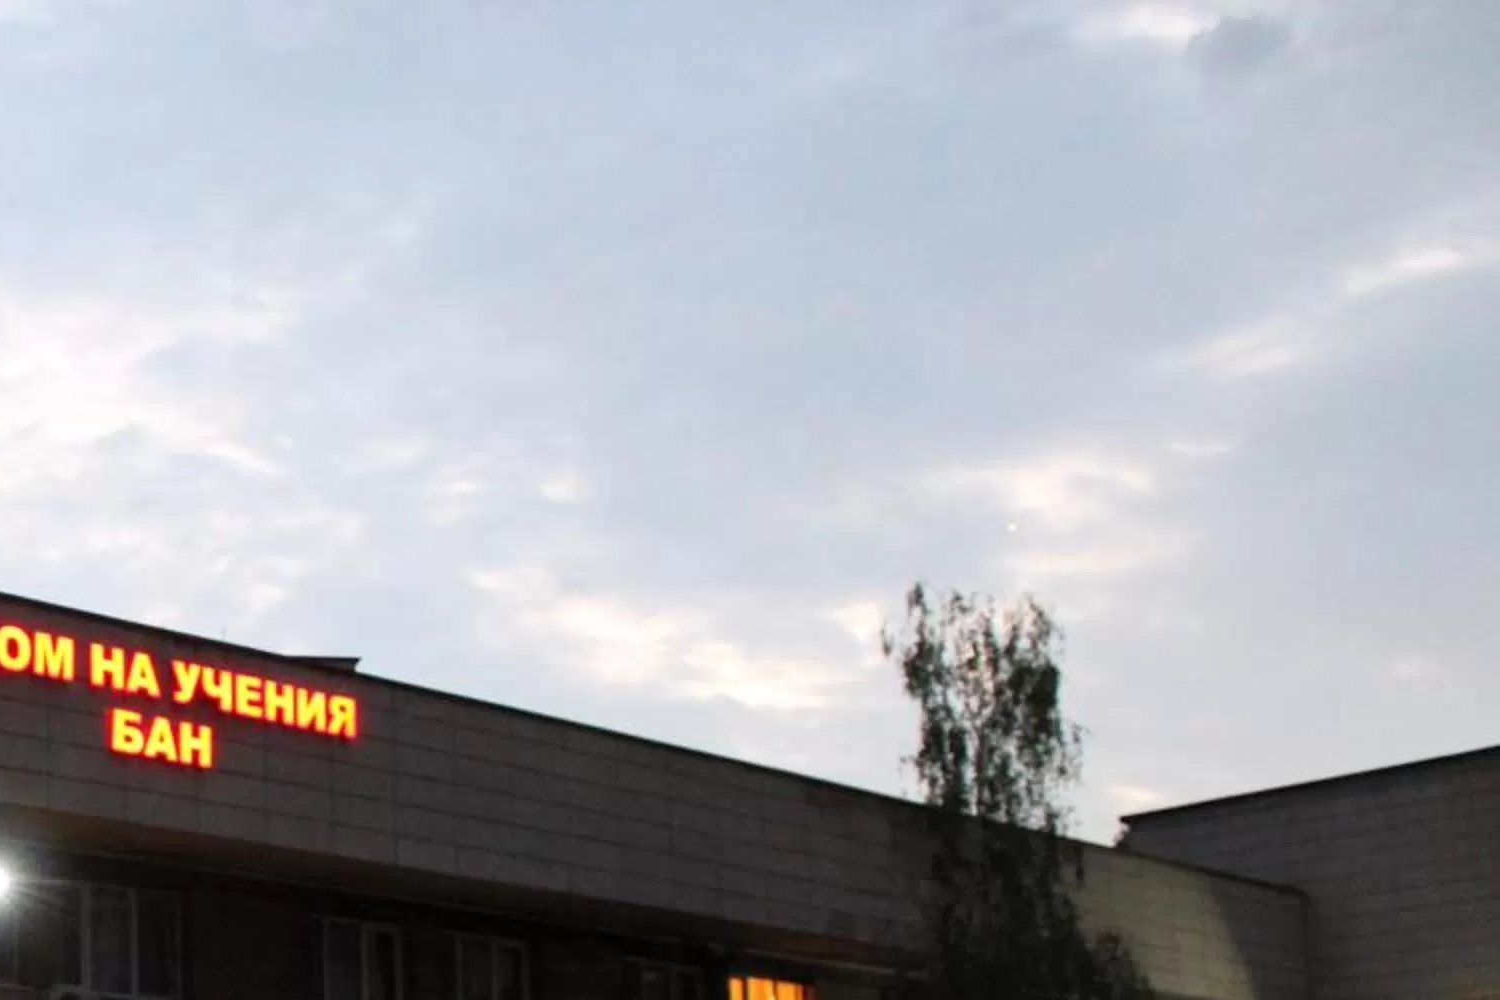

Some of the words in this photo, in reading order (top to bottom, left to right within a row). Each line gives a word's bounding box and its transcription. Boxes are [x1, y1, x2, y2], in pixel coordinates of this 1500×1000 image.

[89, 642, 161, 698] НА
[171, 659, 358, 739] УЧЕНИЯ
[110, 707, 213, 768] БАН
